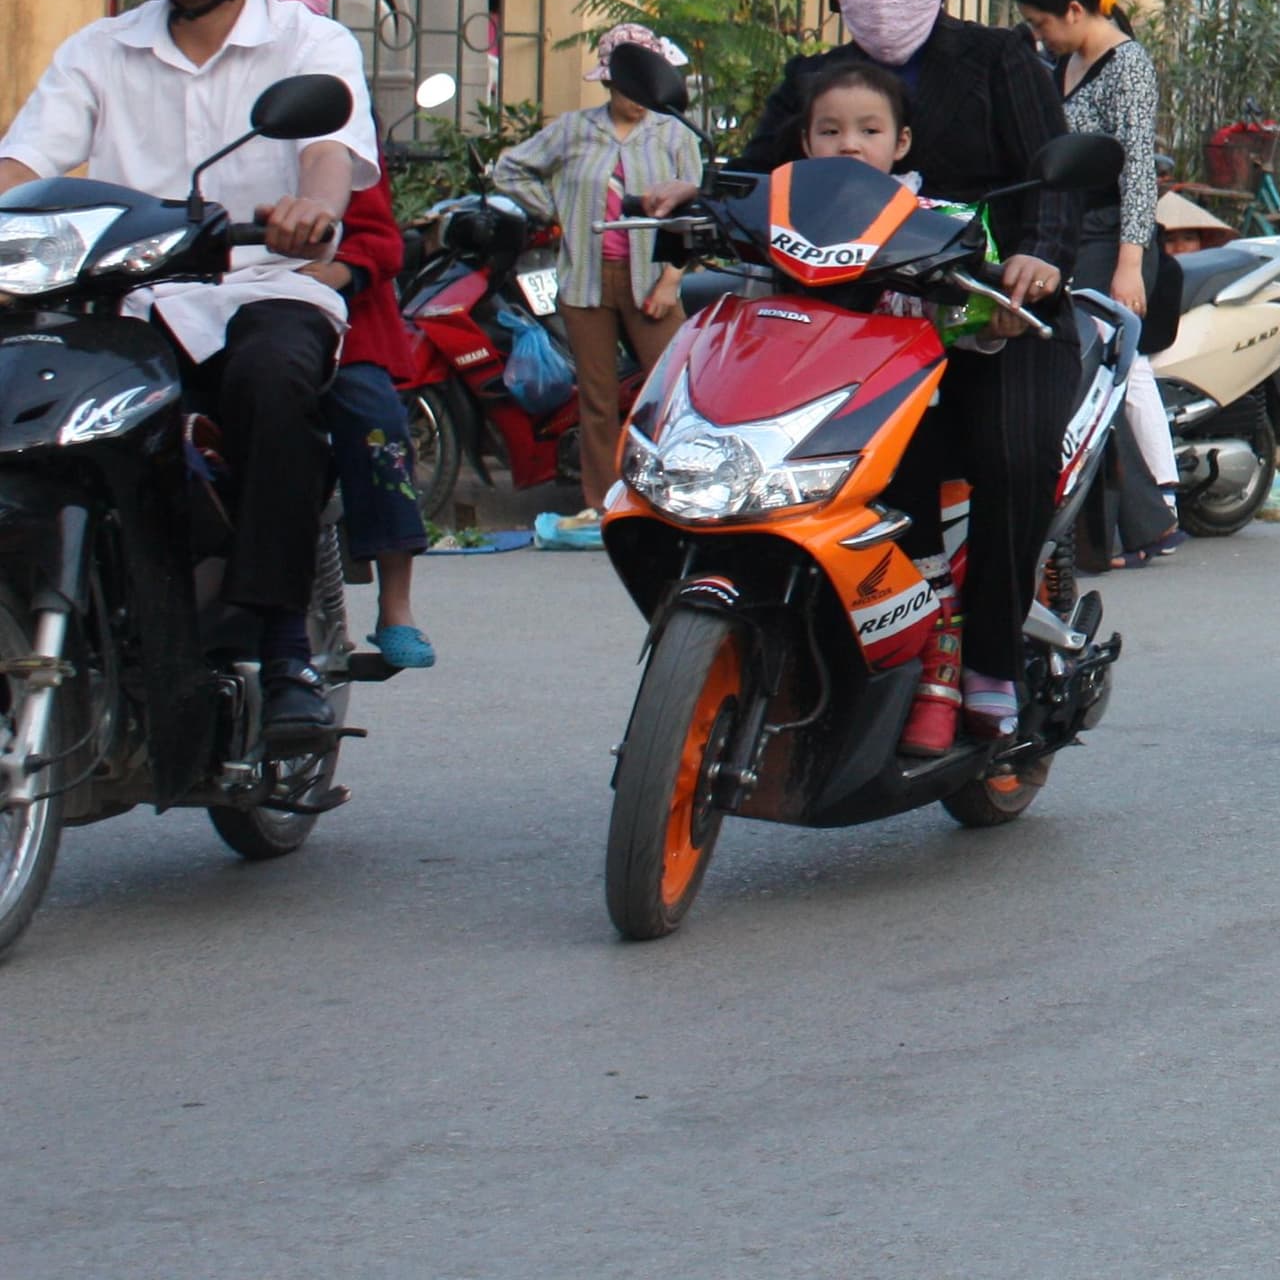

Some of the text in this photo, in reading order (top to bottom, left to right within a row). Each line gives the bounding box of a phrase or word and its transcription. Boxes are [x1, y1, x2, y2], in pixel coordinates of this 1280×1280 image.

[771, 232, 868, 266] REPSOL
[757, 308, 812, 324] HONDA
[1, 333, 65, 345] HONDA
[857, 580, 935, 635] REPSOL
